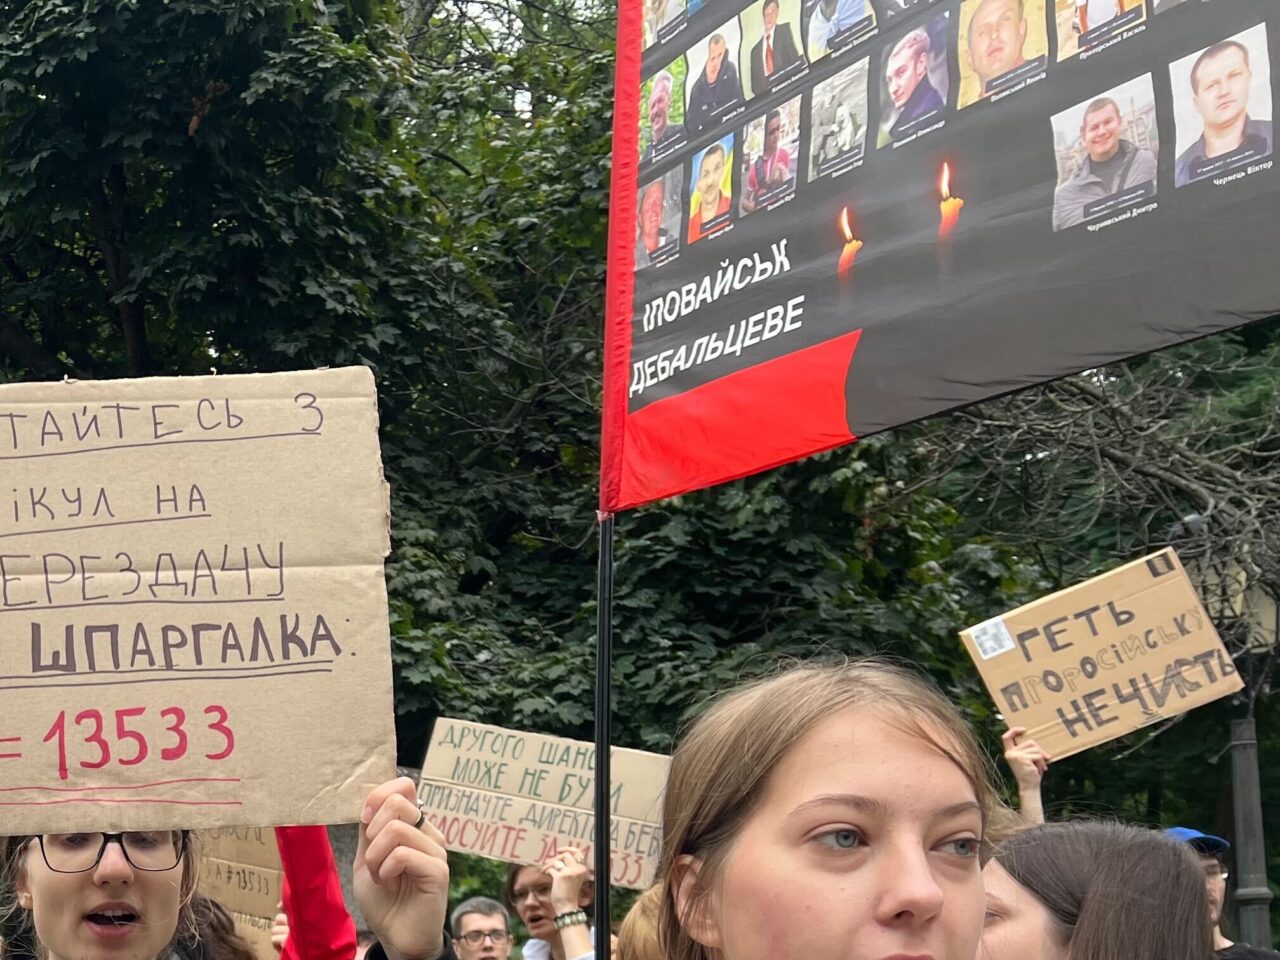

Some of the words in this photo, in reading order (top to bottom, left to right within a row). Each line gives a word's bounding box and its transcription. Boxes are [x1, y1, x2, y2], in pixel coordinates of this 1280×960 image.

[642, 238, 792, 332] ІЛОВАЙСЬК
[629, 295, 805, 398] ДЕБАЛЬЦЕВЕ
[156, 484, 207, 515] НА
[1015, 600, 1136, 662] ГЕТЬ
[1056, 648, 1236, 738] НЕЧИСТЬ
[438, 724, 525, 760] ДРУГОГО
[537, 741, 614, 771] ШАНС
[451, 756, 508, 790] МОЖЕ
[519, 767, 550, 798] НЕ
[558, 773, 623, 814] БУИ
[423, 812, 528, 859] ЛОСУЙТЕ
[519, 802, 620, 848] ДИРЕКТА
